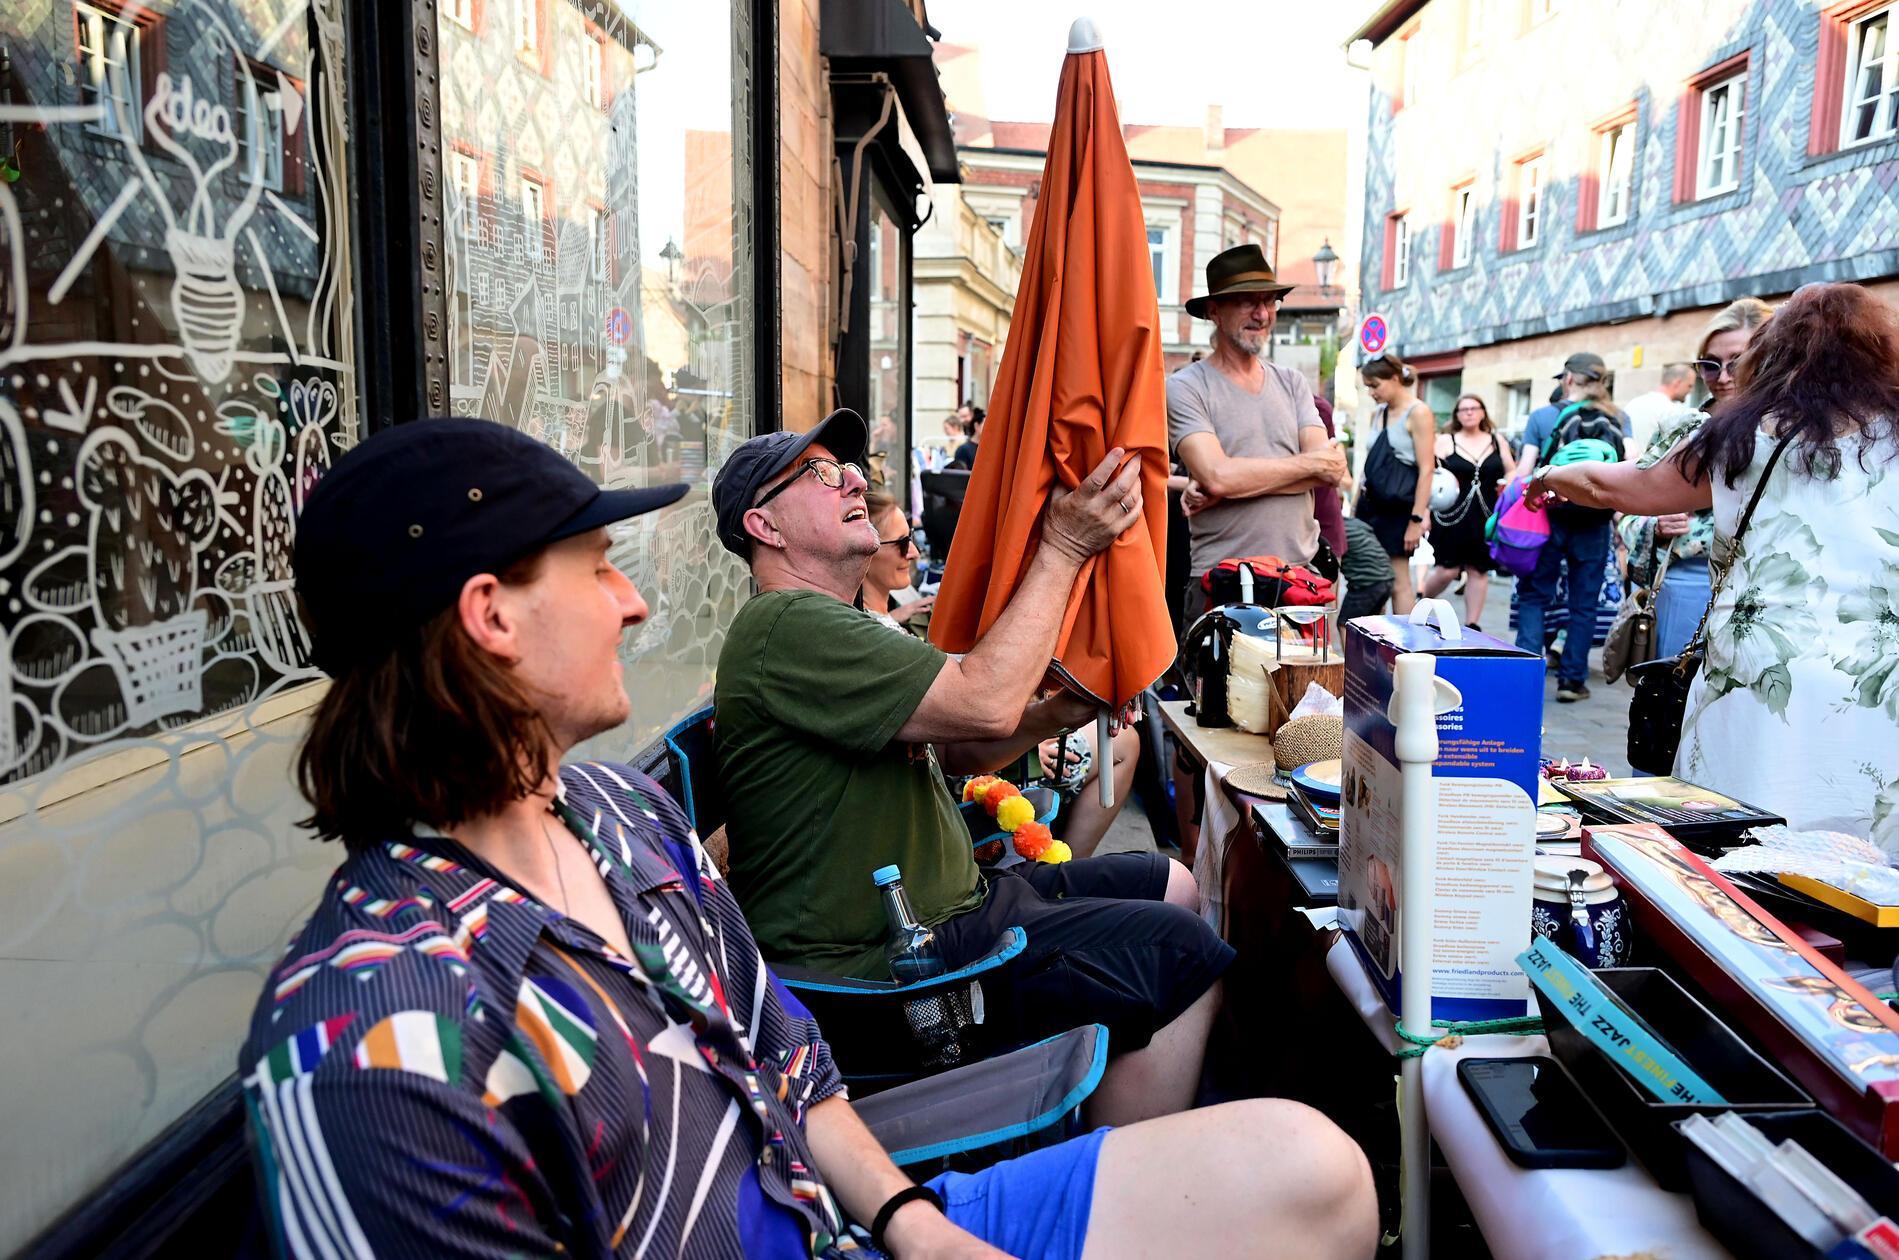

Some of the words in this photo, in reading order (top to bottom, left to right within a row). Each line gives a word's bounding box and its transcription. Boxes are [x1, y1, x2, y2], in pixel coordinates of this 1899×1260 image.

[1434, 713, 1464, 722] ssoires
[1527, 949, 1552, 972] JAZZ
[1432, 968, 1525, 977] www.friedlandproducts.com
[1568, 992, 1592, 1017] THE
[1591, 1015, 1631, 1047] JAZZ
[1670, 1082, 1701, 1104] HE
